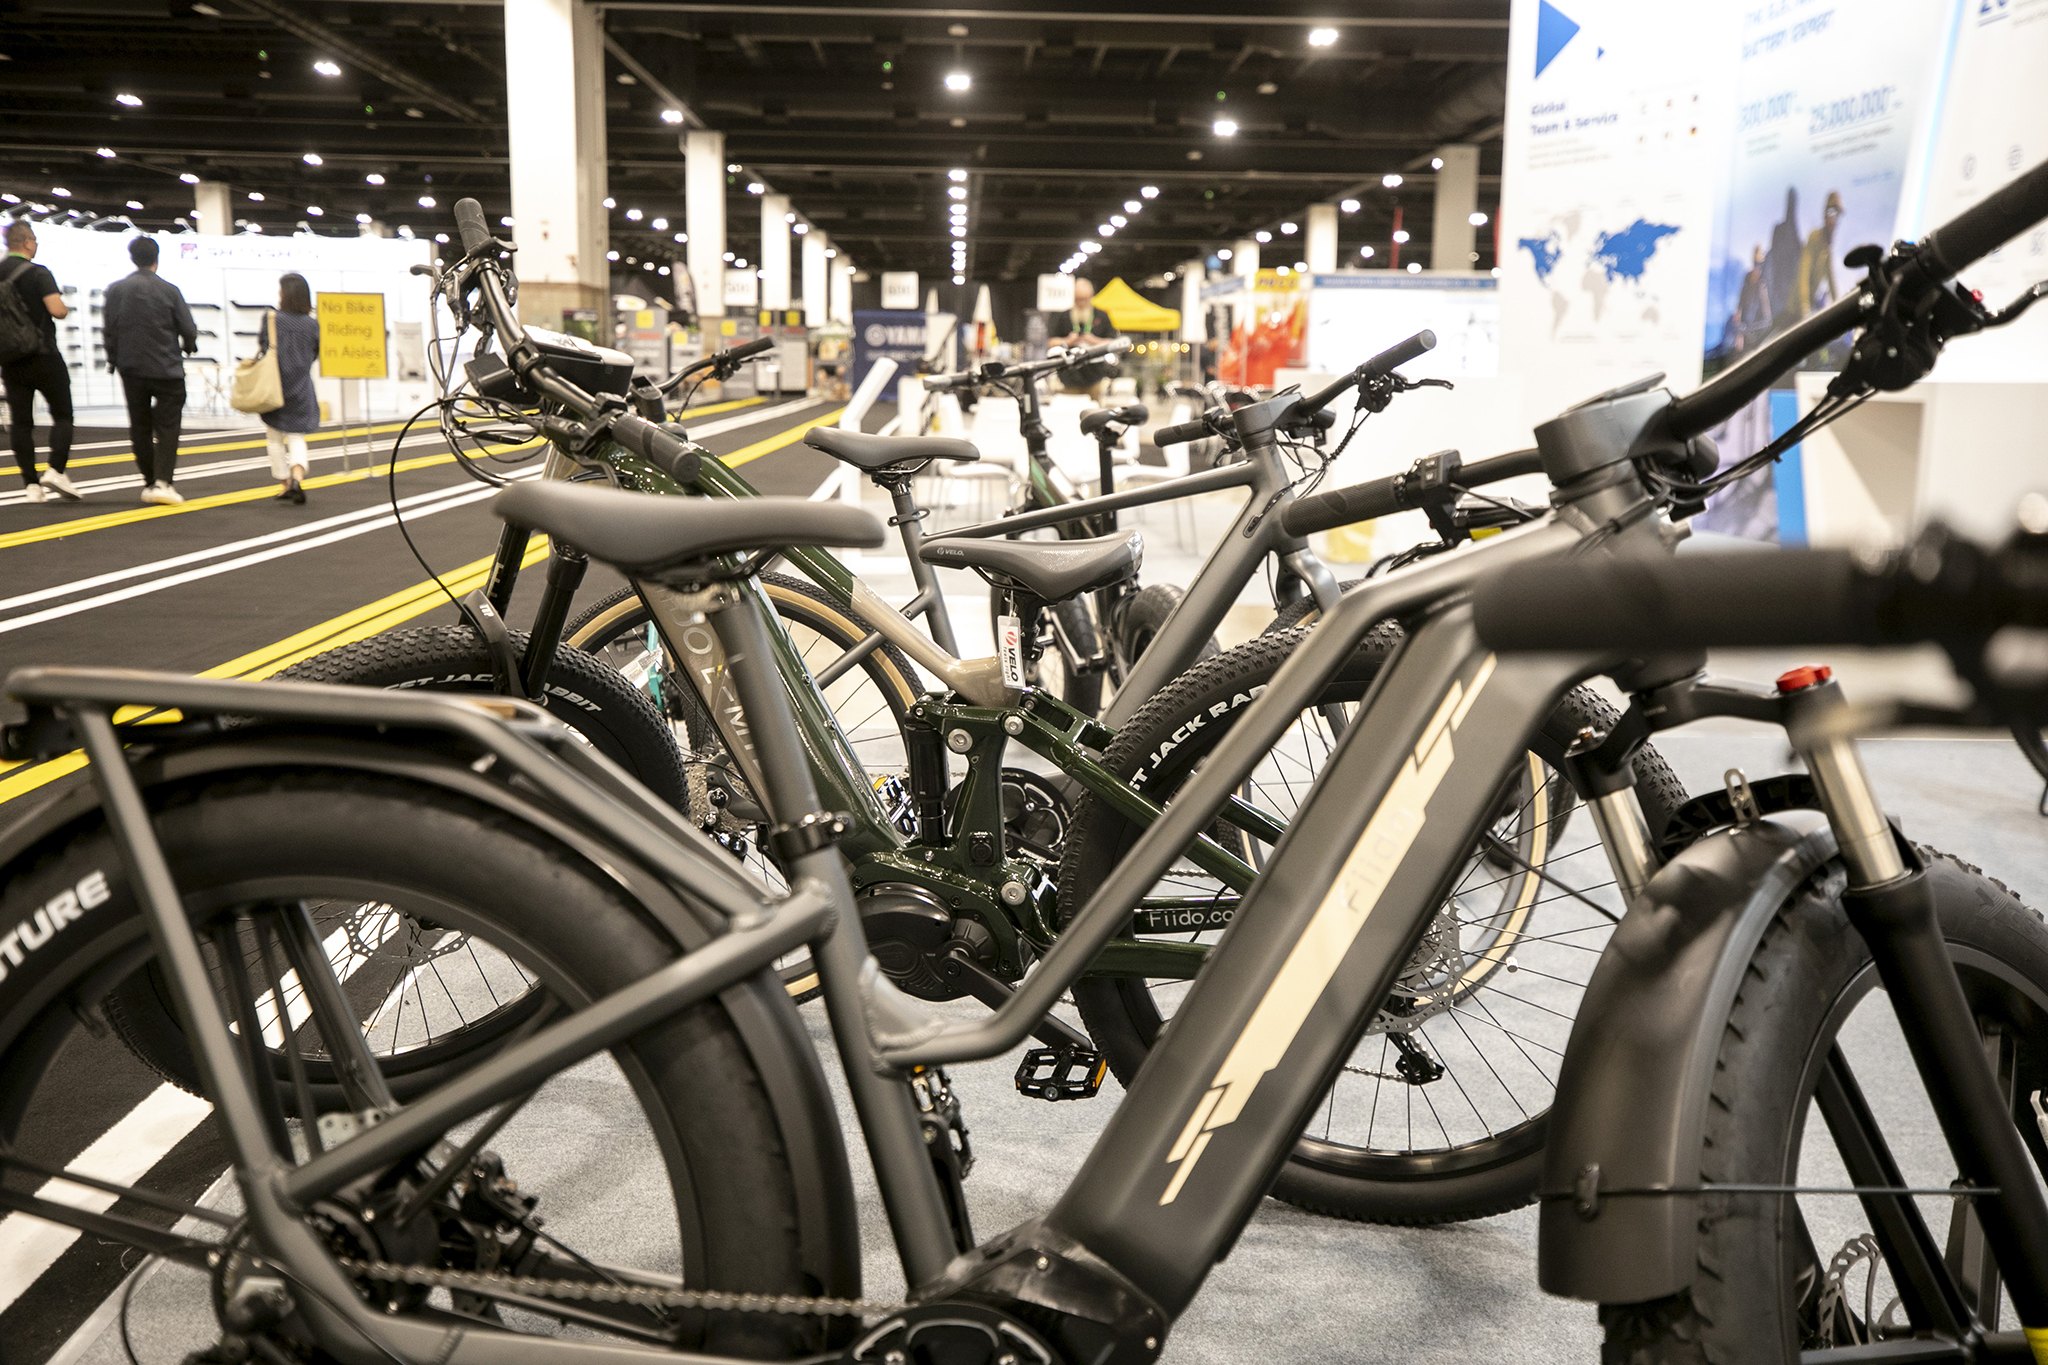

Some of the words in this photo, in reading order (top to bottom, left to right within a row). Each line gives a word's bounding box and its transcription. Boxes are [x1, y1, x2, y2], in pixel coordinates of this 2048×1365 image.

[321, 301, 342, 314] No
[346, 301, 374, 314] Bike
[327, 322, 371, 340] Riding
[324, 346, 338, 358] in
[342, 345, 380, 359] Aisles
[1008, 647, 1019, 682] VELO
[436, 674, 502, 684] JAC
[1150, 714, 1207, 769] JACK
[0, 868, 112, 984] TURE
